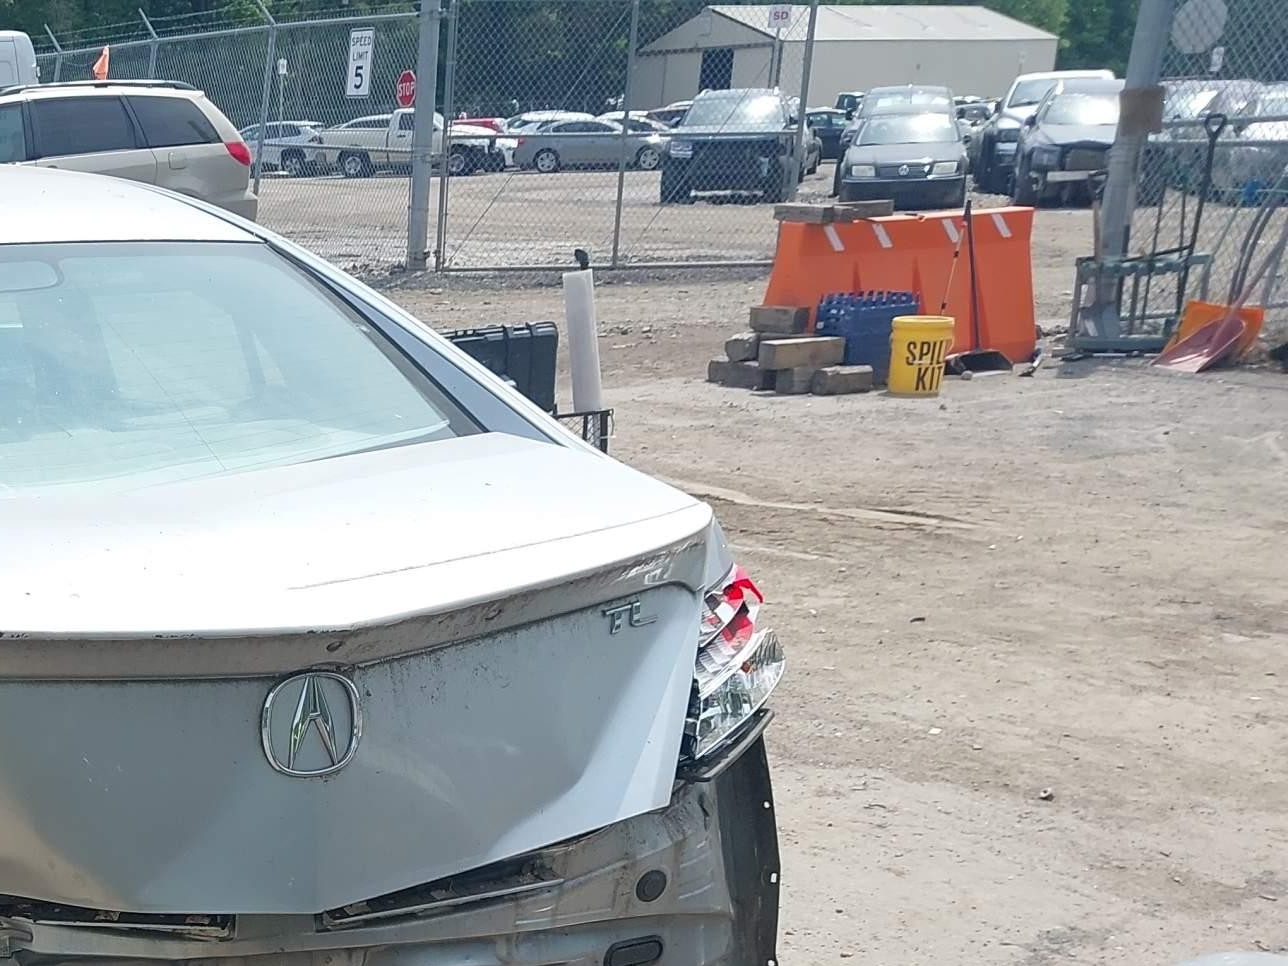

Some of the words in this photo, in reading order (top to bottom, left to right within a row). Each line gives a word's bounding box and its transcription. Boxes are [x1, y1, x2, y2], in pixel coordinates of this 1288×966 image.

[352, 36, 371, 46] SPEED
[353, 51, 368, 61] LIMIT
[354, 65, 364, 89] 5
[398, 82, 415, 97] STOP
[601, 600, 657, 634] TL
